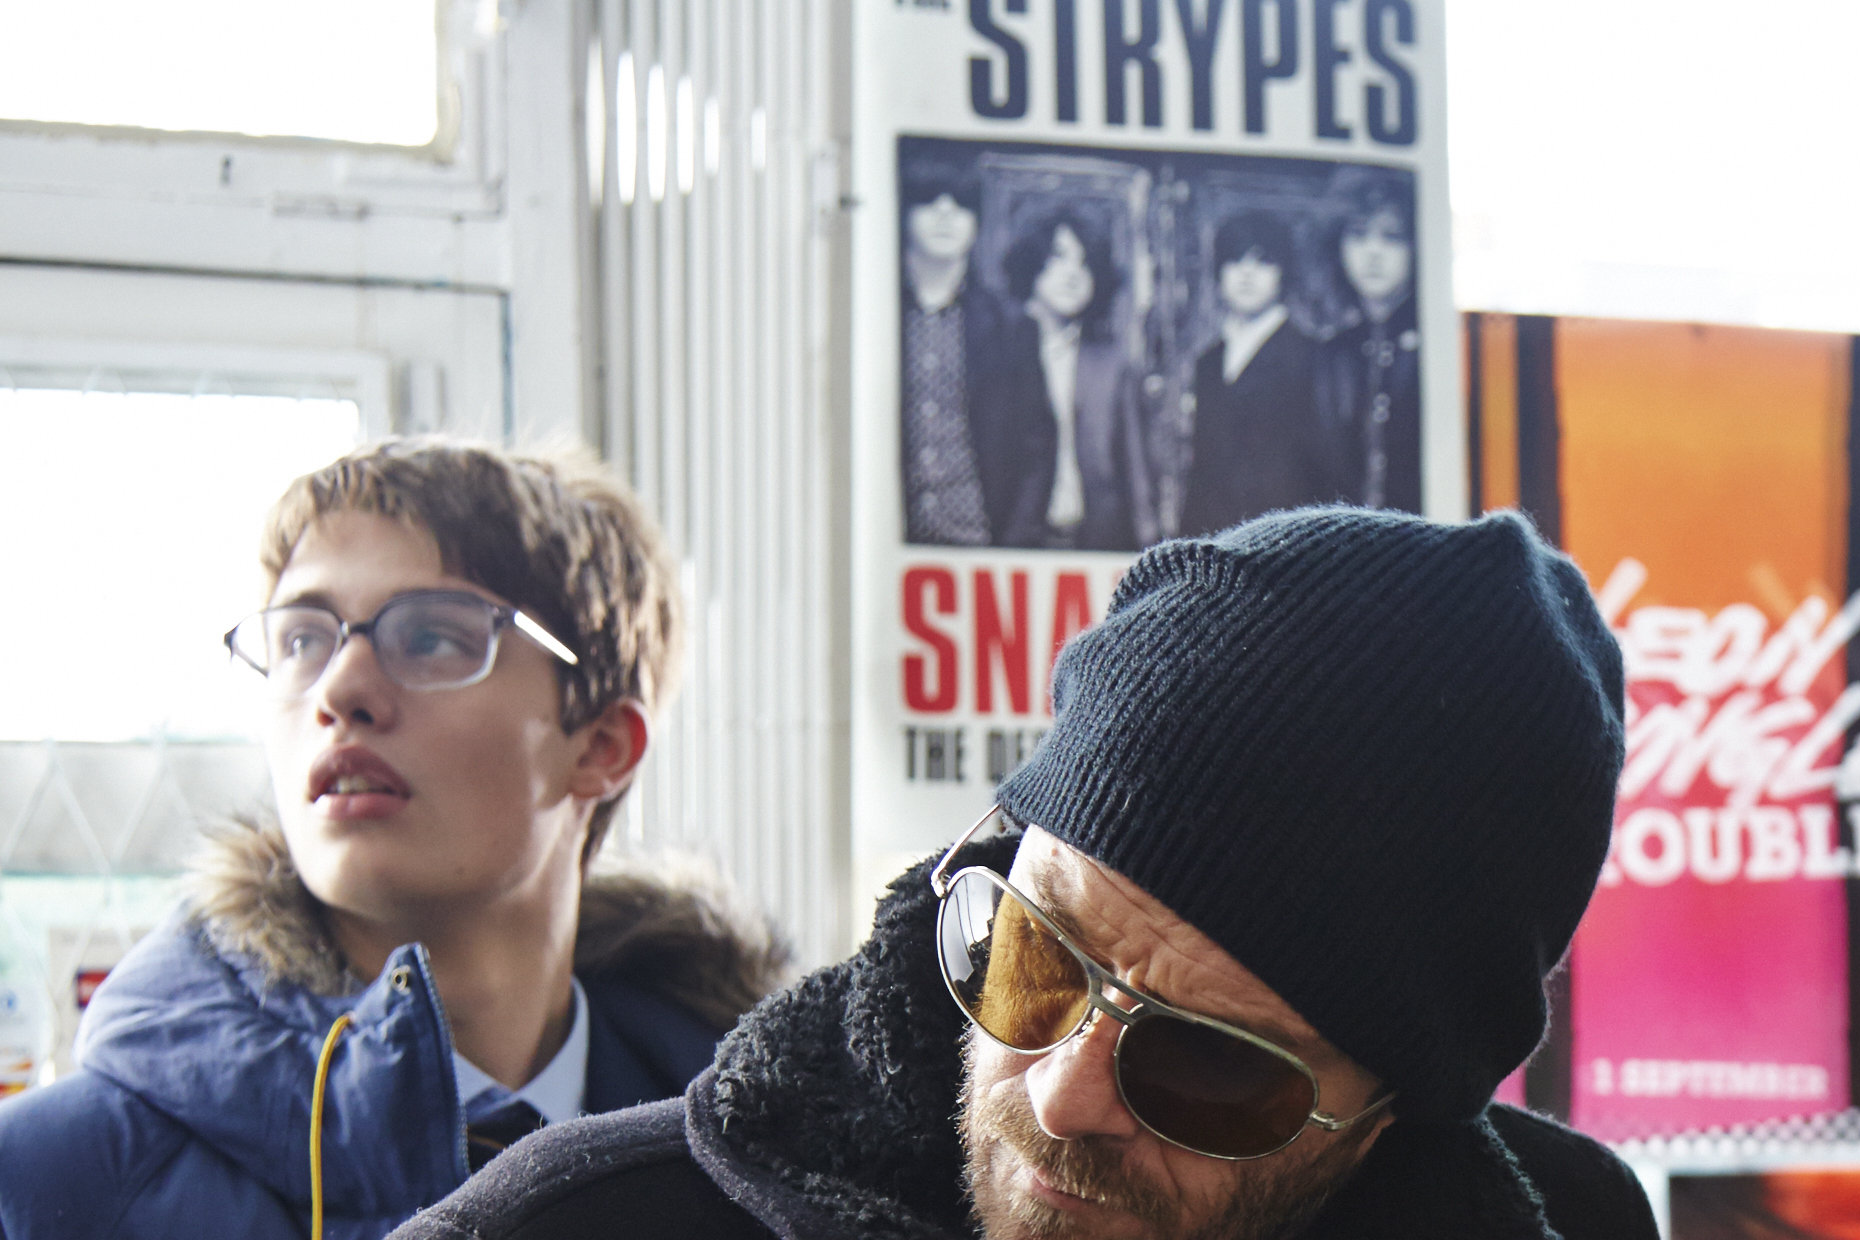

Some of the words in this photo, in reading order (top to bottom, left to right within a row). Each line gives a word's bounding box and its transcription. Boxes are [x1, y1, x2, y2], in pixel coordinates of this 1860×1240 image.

[902, 565, 1128, 716] SNA
[905, 727, 964, 783] THE
[1621, 1058, 1828, 1101] SEPTEMBER
